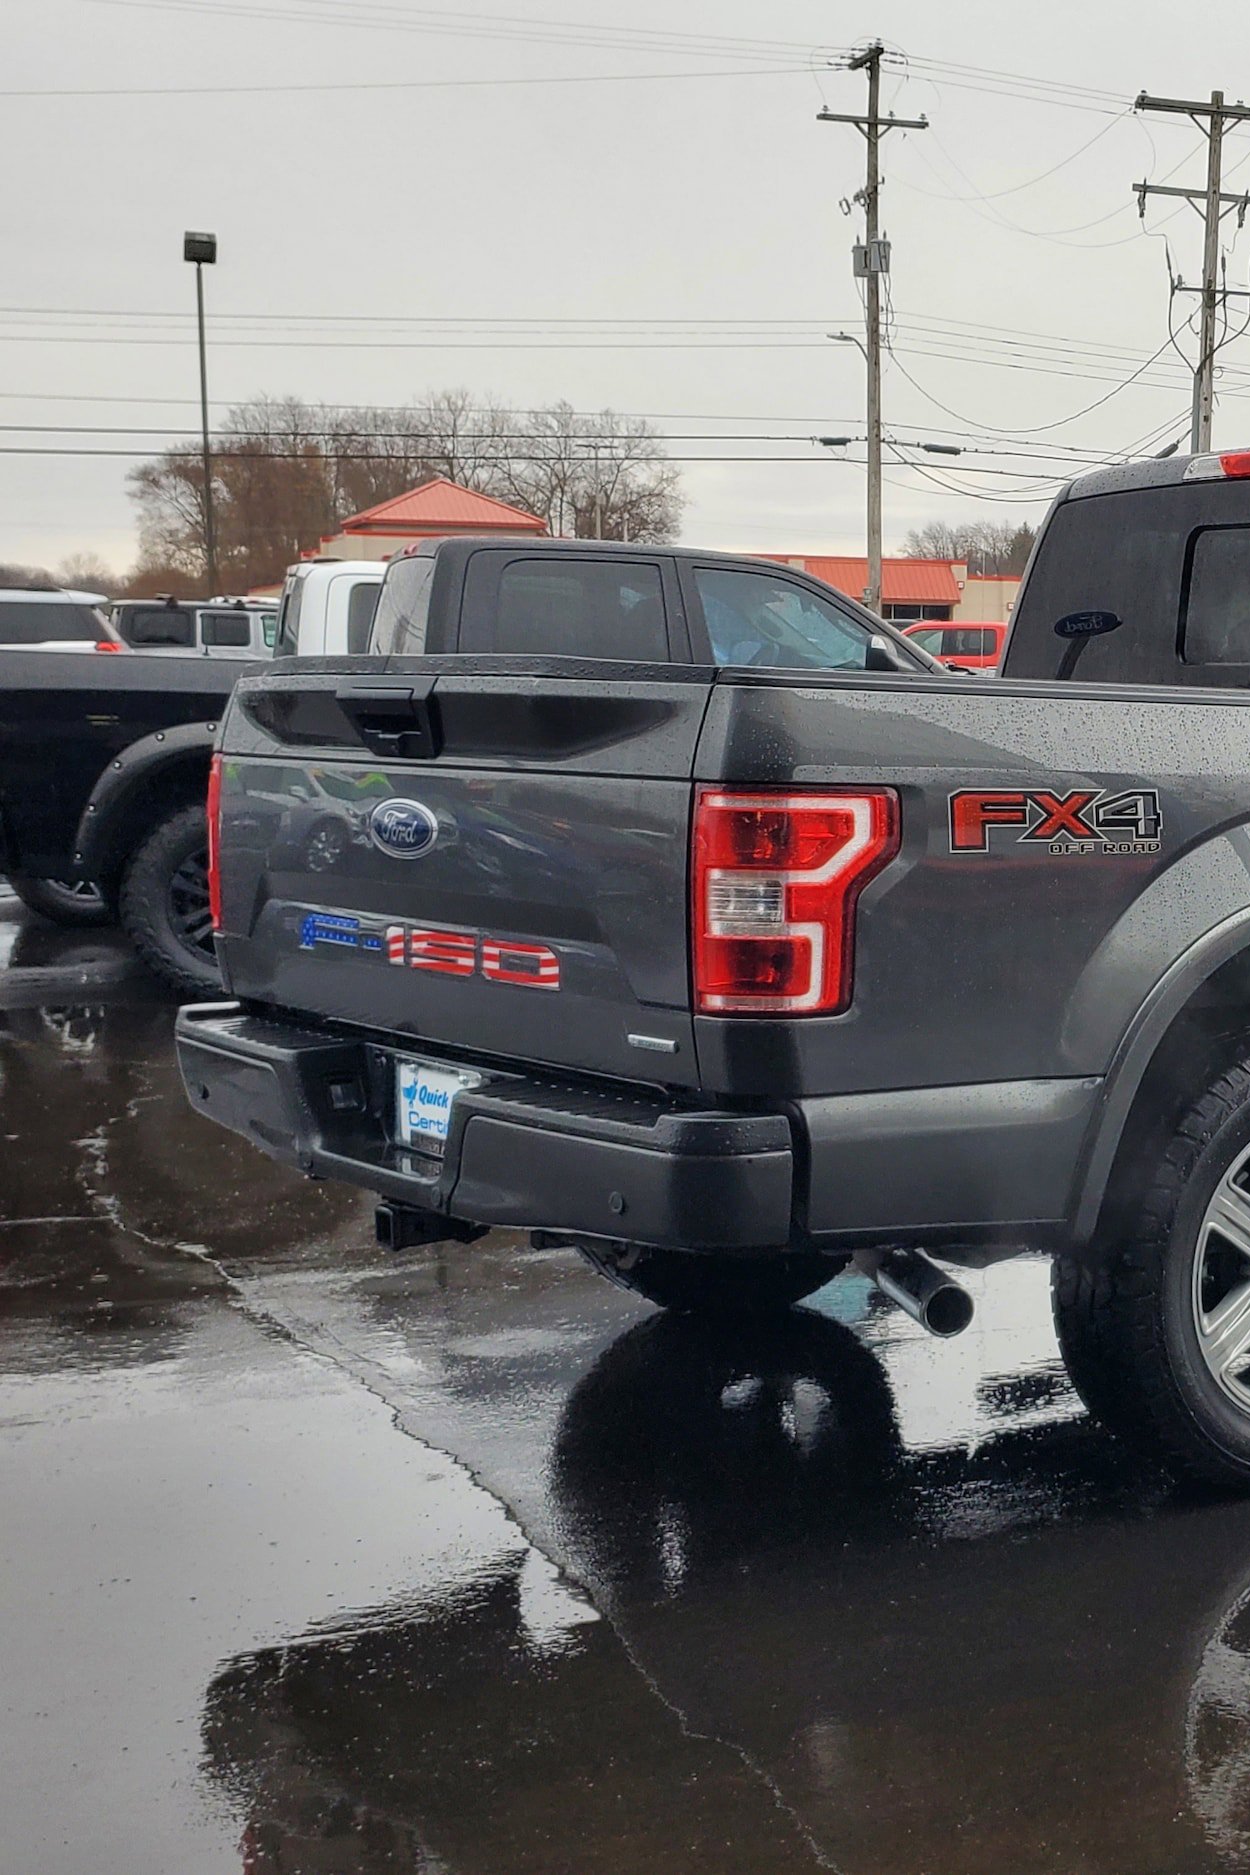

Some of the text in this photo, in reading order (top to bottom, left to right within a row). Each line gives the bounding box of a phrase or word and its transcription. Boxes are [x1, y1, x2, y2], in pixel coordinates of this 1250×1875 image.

[948, 788, 1163, 853] FX4
[1049, 841, 1161, 855] OFF ROAD
[299, 913, 562, 991] F-150
[419, 1085, 450, 1109] Quick
[408, 1111, 452, 1134] Certi
